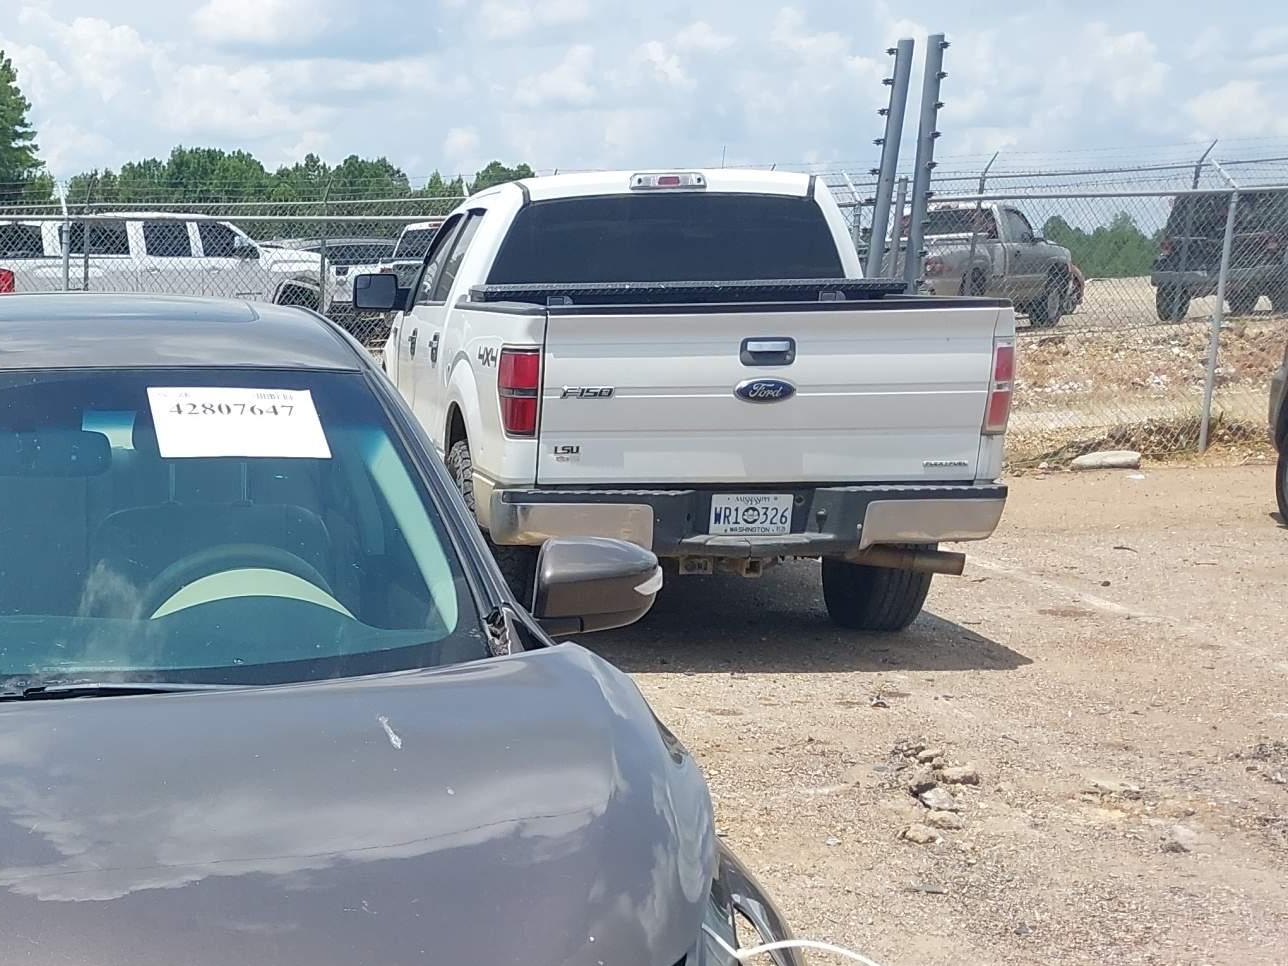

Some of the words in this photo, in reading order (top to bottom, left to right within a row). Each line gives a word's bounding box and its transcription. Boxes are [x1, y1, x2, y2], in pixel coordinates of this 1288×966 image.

[748, 382, 783, 397] Ford
[169, 402, 294, 416] 42807647
[554, 445, 580, 454] LSU
